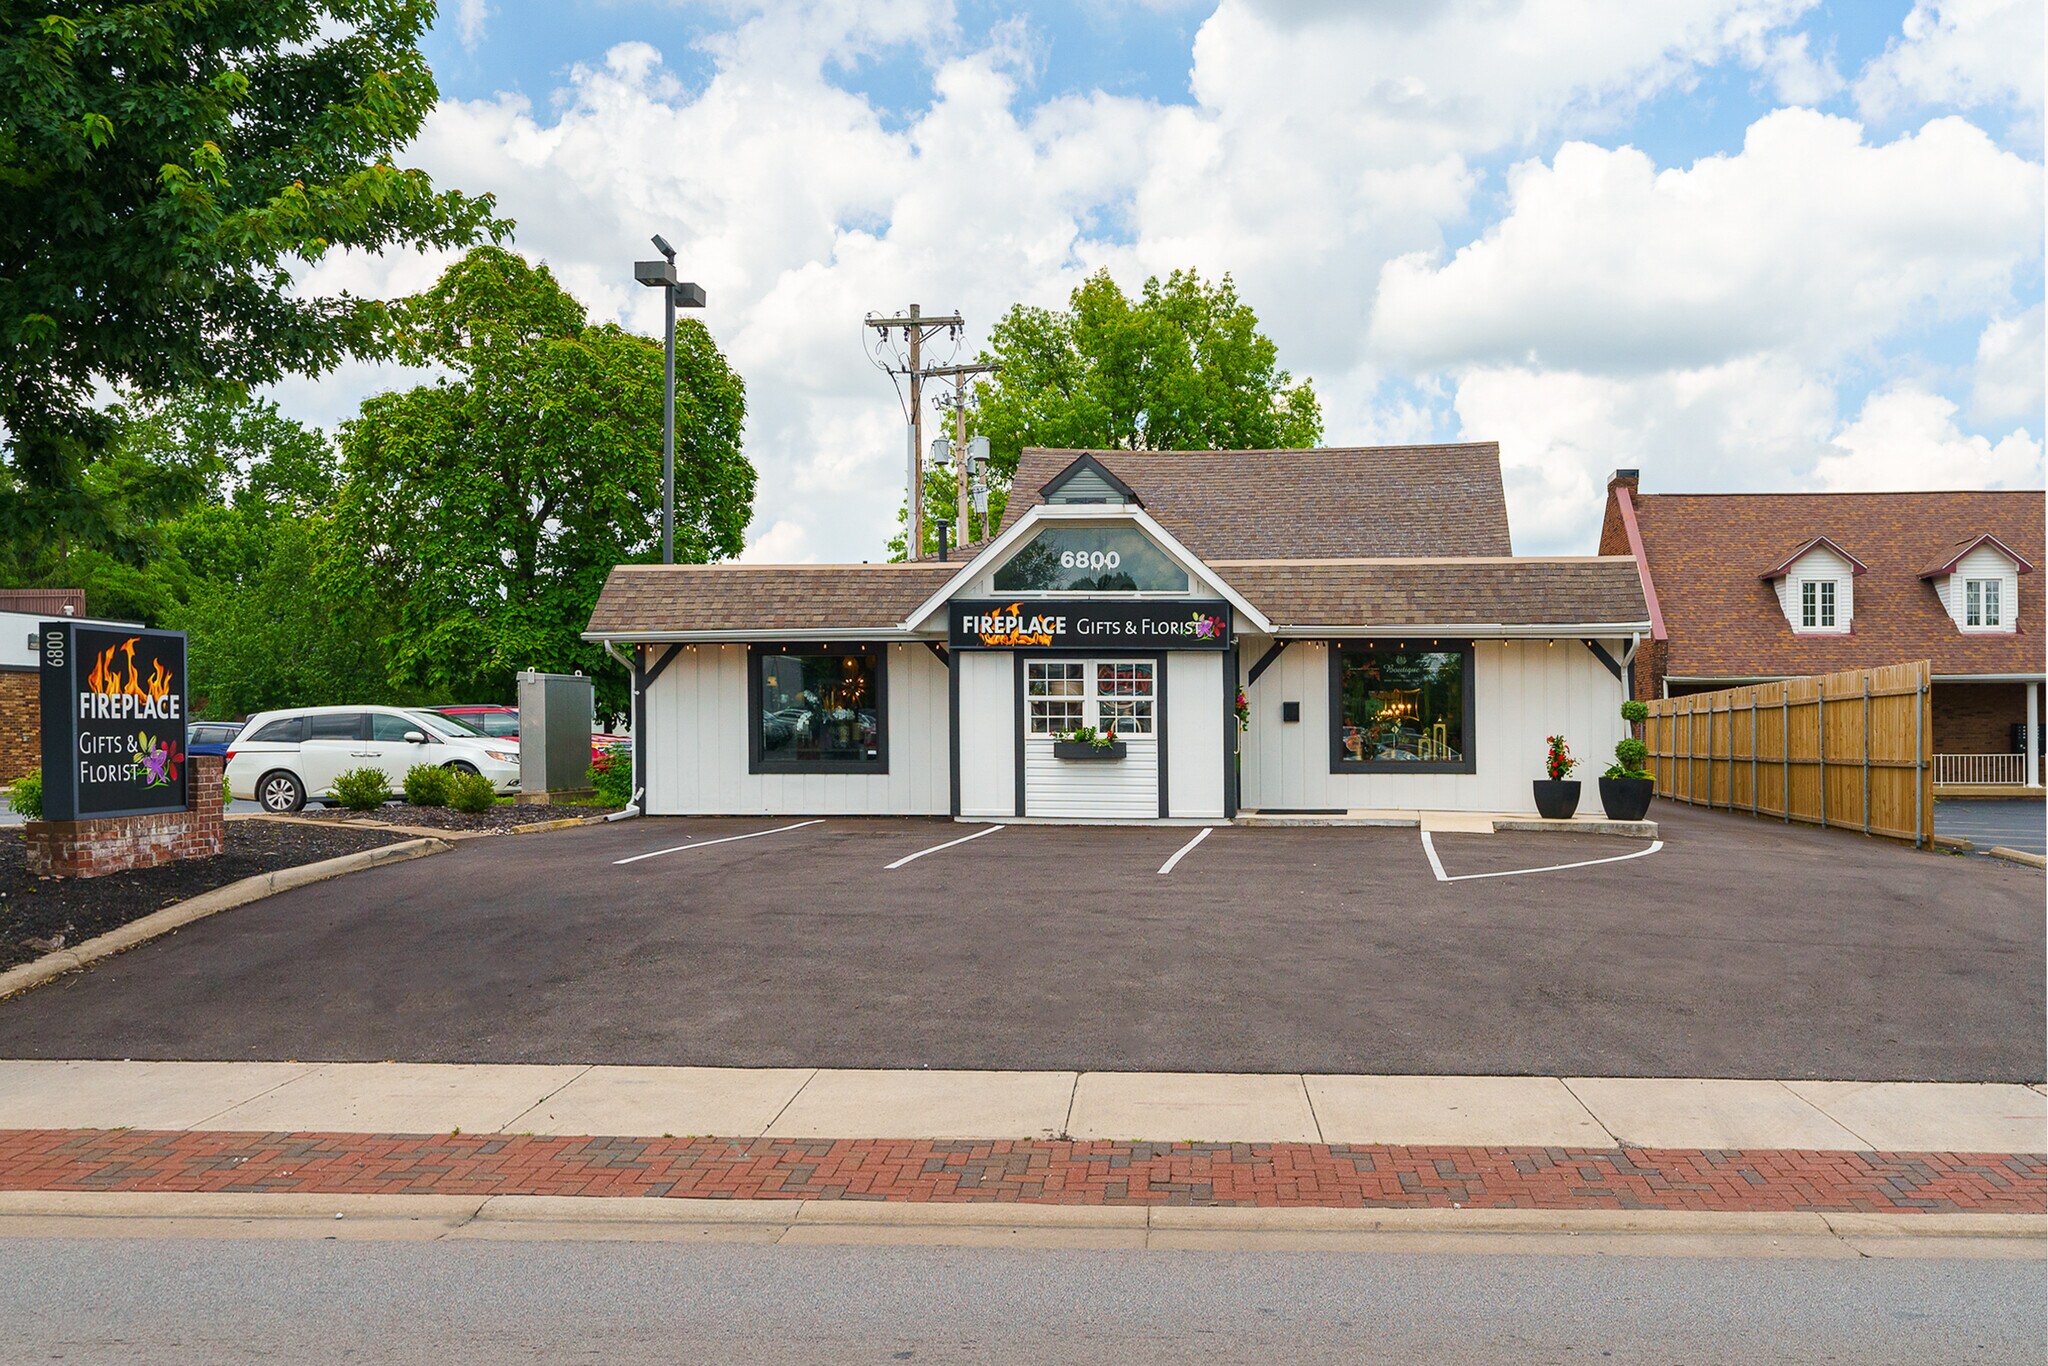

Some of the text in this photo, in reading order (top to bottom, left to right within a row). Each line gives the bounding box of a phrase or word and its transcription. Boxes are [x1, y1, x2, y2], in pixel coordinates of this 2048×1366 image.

[1060, 551, 1121, 570] 6800
[963, 616, 1201, 636] FIREPLACE GIFTS & FLORIST
[46, 631, 64, 668] 6800
[1100, 670, 1150, 693] OPEN
[80, 692, 180, 720] FIREPLACE
[79, 731, 138, 755] GIFTS &
[80, 761, 139, 784] FLORIST
